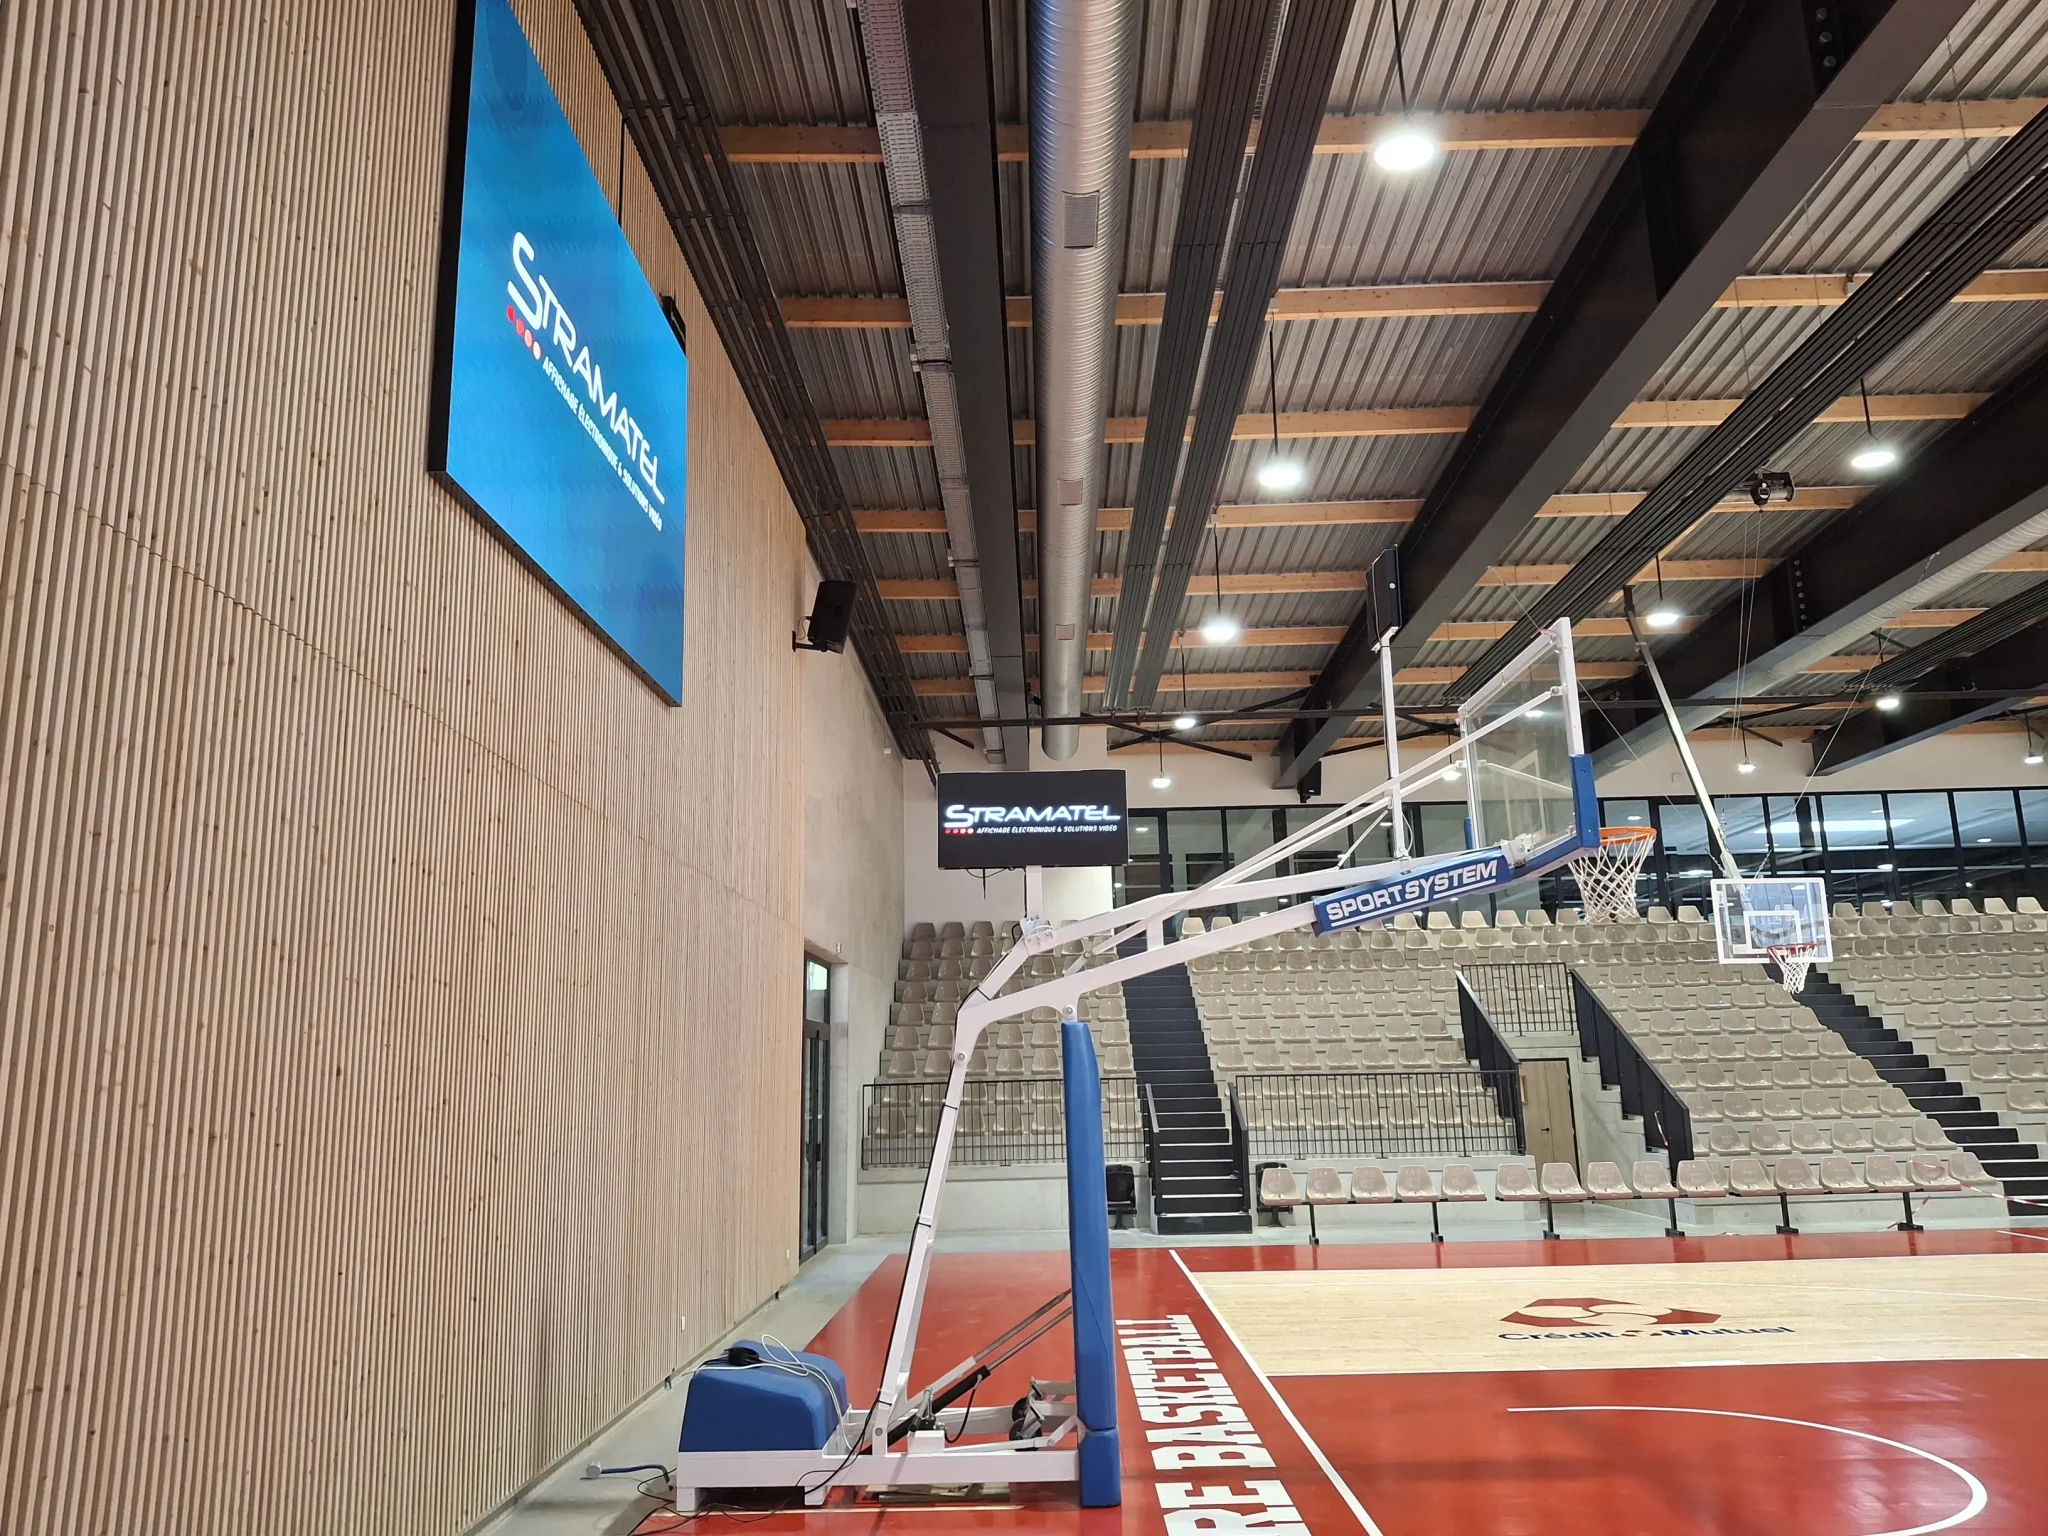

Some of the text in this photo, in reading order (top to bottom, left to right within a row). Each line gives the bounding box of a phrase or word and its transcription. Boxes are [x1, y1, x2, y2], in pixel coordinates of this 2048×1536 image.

[507, 231, 666, 505] STRAMATEL
[542, 356, 580, 415] AFFICHAGE
[577, 402, 619, 471] ÉLECTRONIQUE
[622, 468, 649, 514] SOLUTIONS
[648, 503, 663, 532] VIDÉO
[943, 804, 1121, 828] STRAMATEL
[976, 826, 1011, 834] AFFICHAGE
[1011, 825, 1056, 834] ÉLECTRONIQUE
[1063, 825, 1098, 833] SOLUTIONS
[1098, 824, 1118, 832] VIDÉO
[1499, 1326, 1796, 1341] Crédit Mutuel
[1114, 1314, 1277, 1471] BASKETBALL
